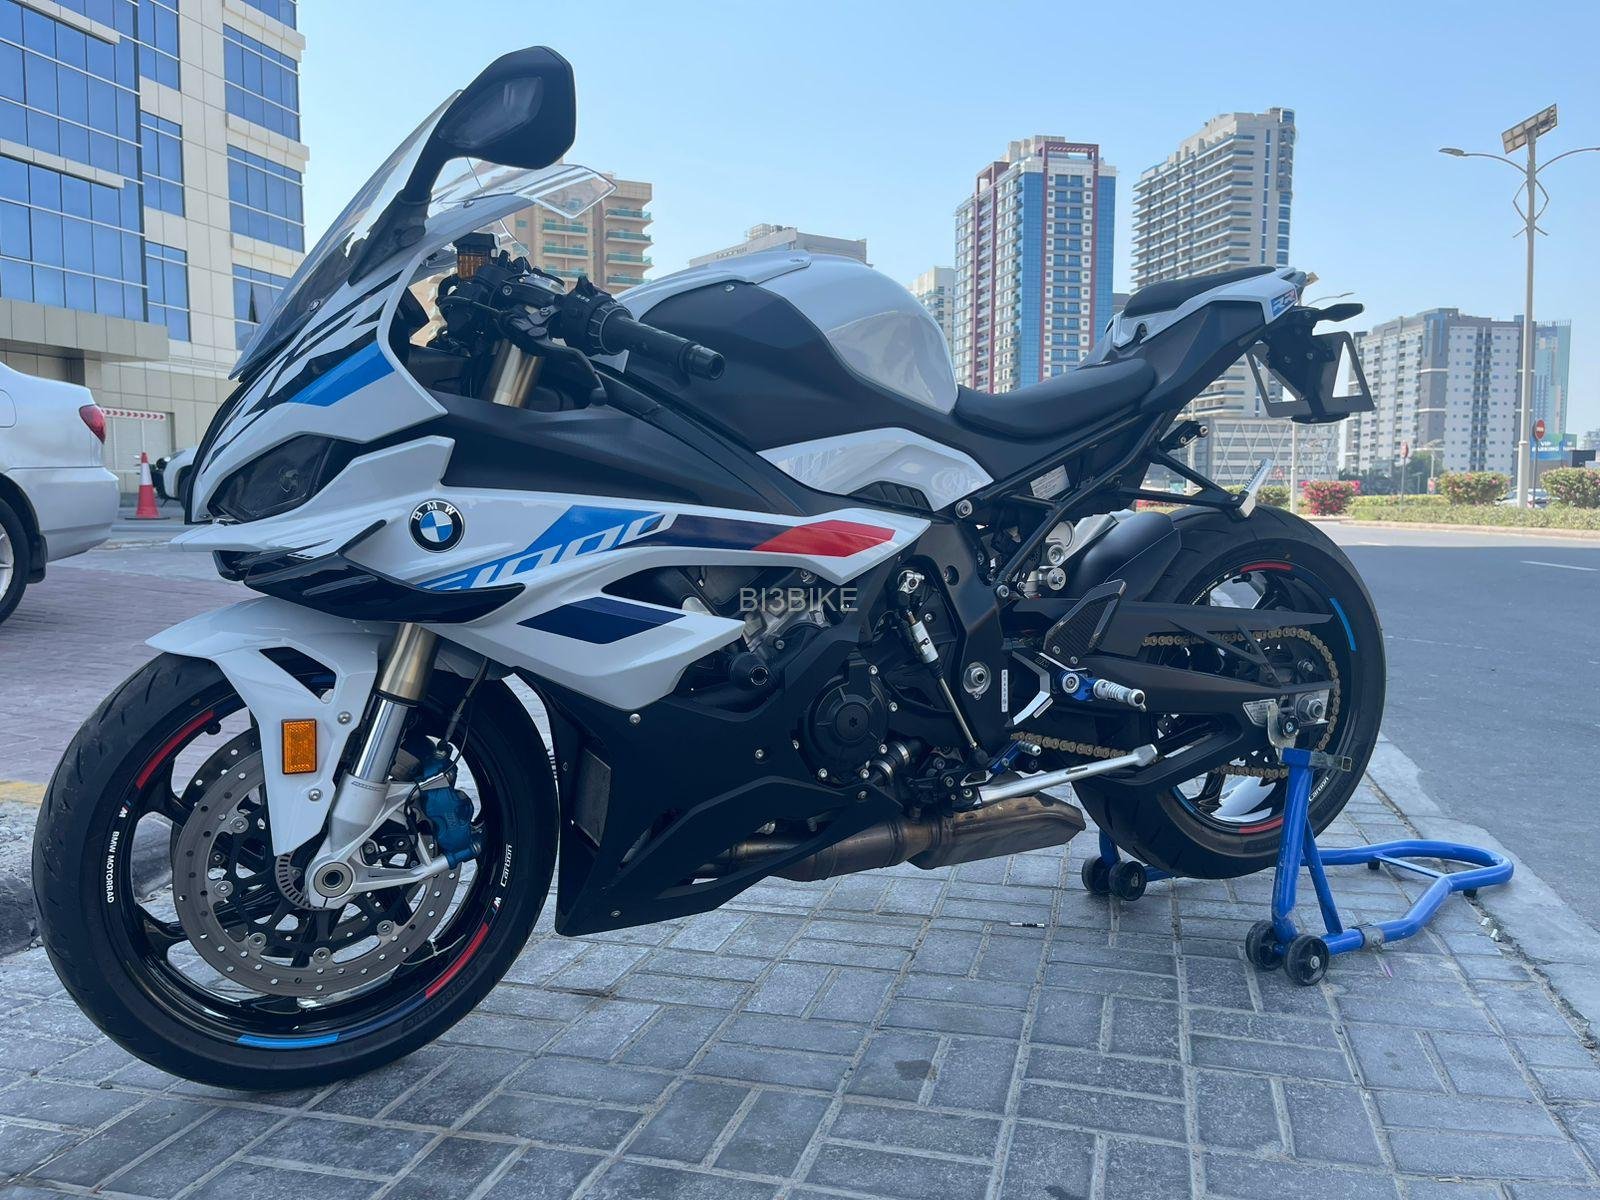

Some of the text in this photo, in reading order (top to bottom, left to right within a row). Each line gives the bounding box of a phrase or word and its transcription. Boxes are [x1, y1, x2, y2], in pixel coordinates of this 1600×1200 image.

[413, 501, 456, 521] BMW
[109, 831, 120, 853] BMW
[106, 855, 115, 903] MOTORRAD
[500, 843, 513, 888] Carbon
